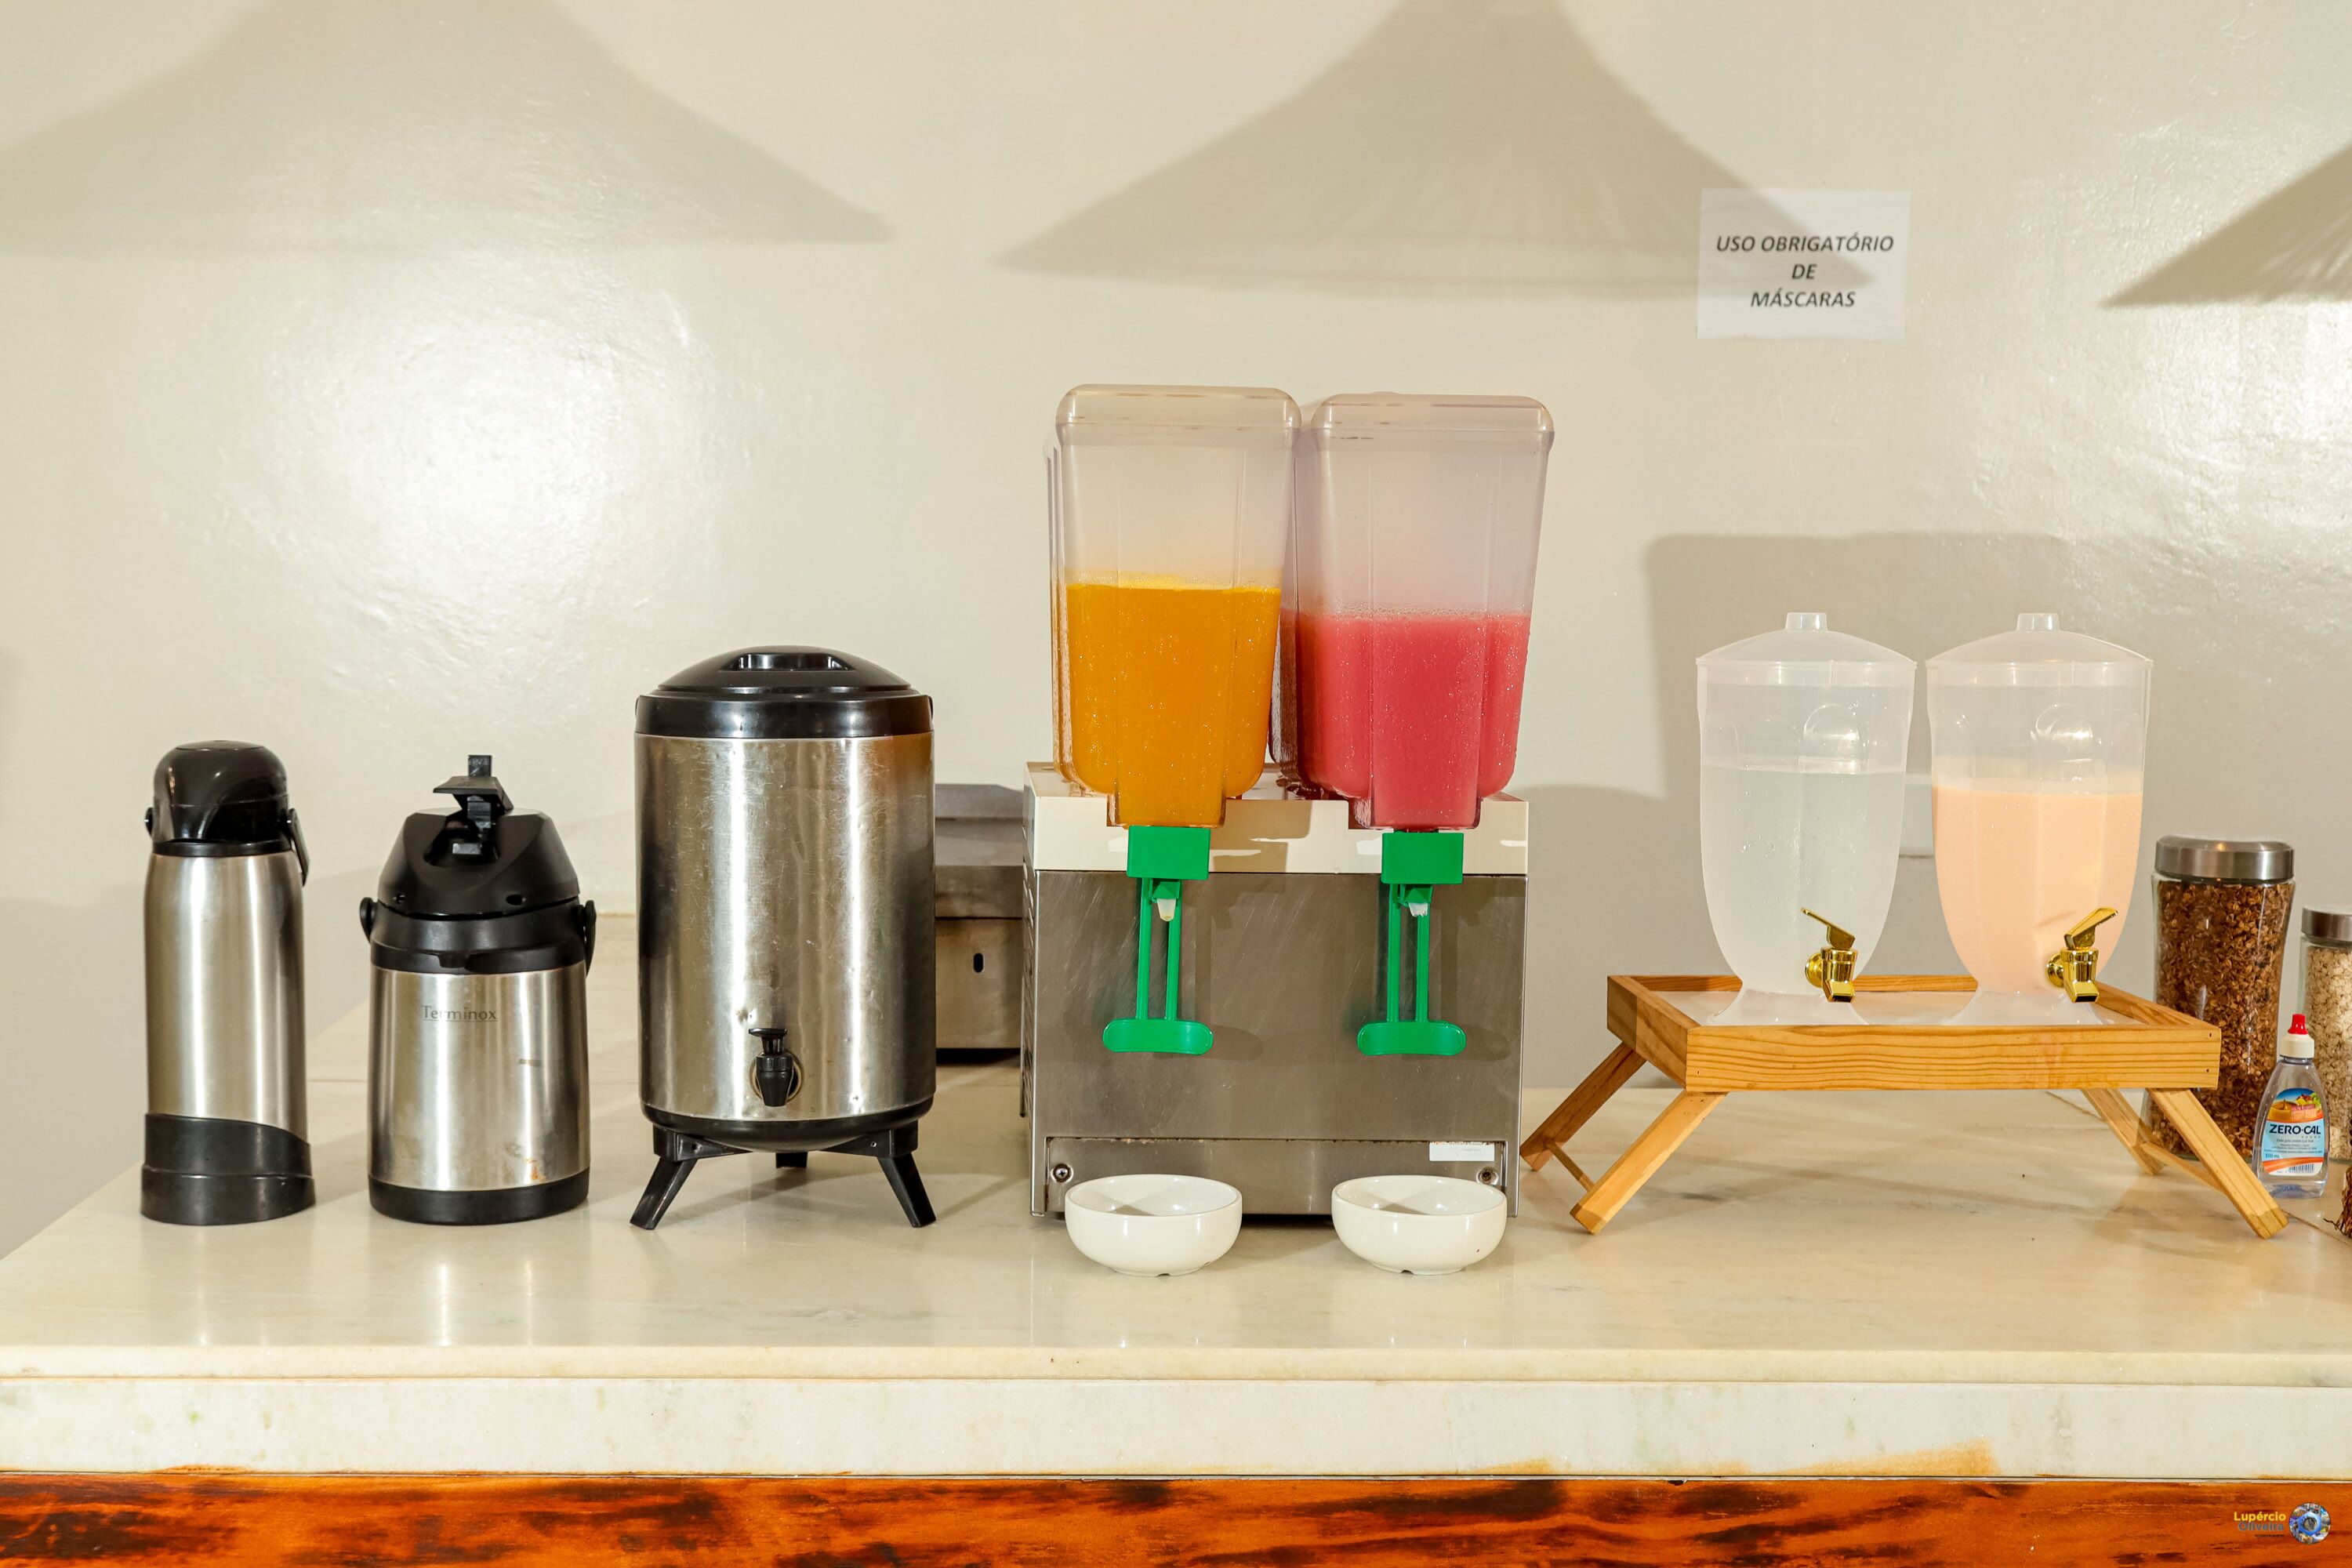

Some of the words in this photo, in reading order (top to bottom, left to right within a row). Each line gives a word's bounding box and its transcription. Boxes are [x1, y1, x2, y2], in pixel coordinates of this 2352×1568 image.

[1716, 235, 1756, 252] USO
[1761, 231, 1895, 252] OBRIGATÓRIO
[1791, 263, 1818, 281] DE
[1750, 287, 1857, 308] MÁSCARAS
